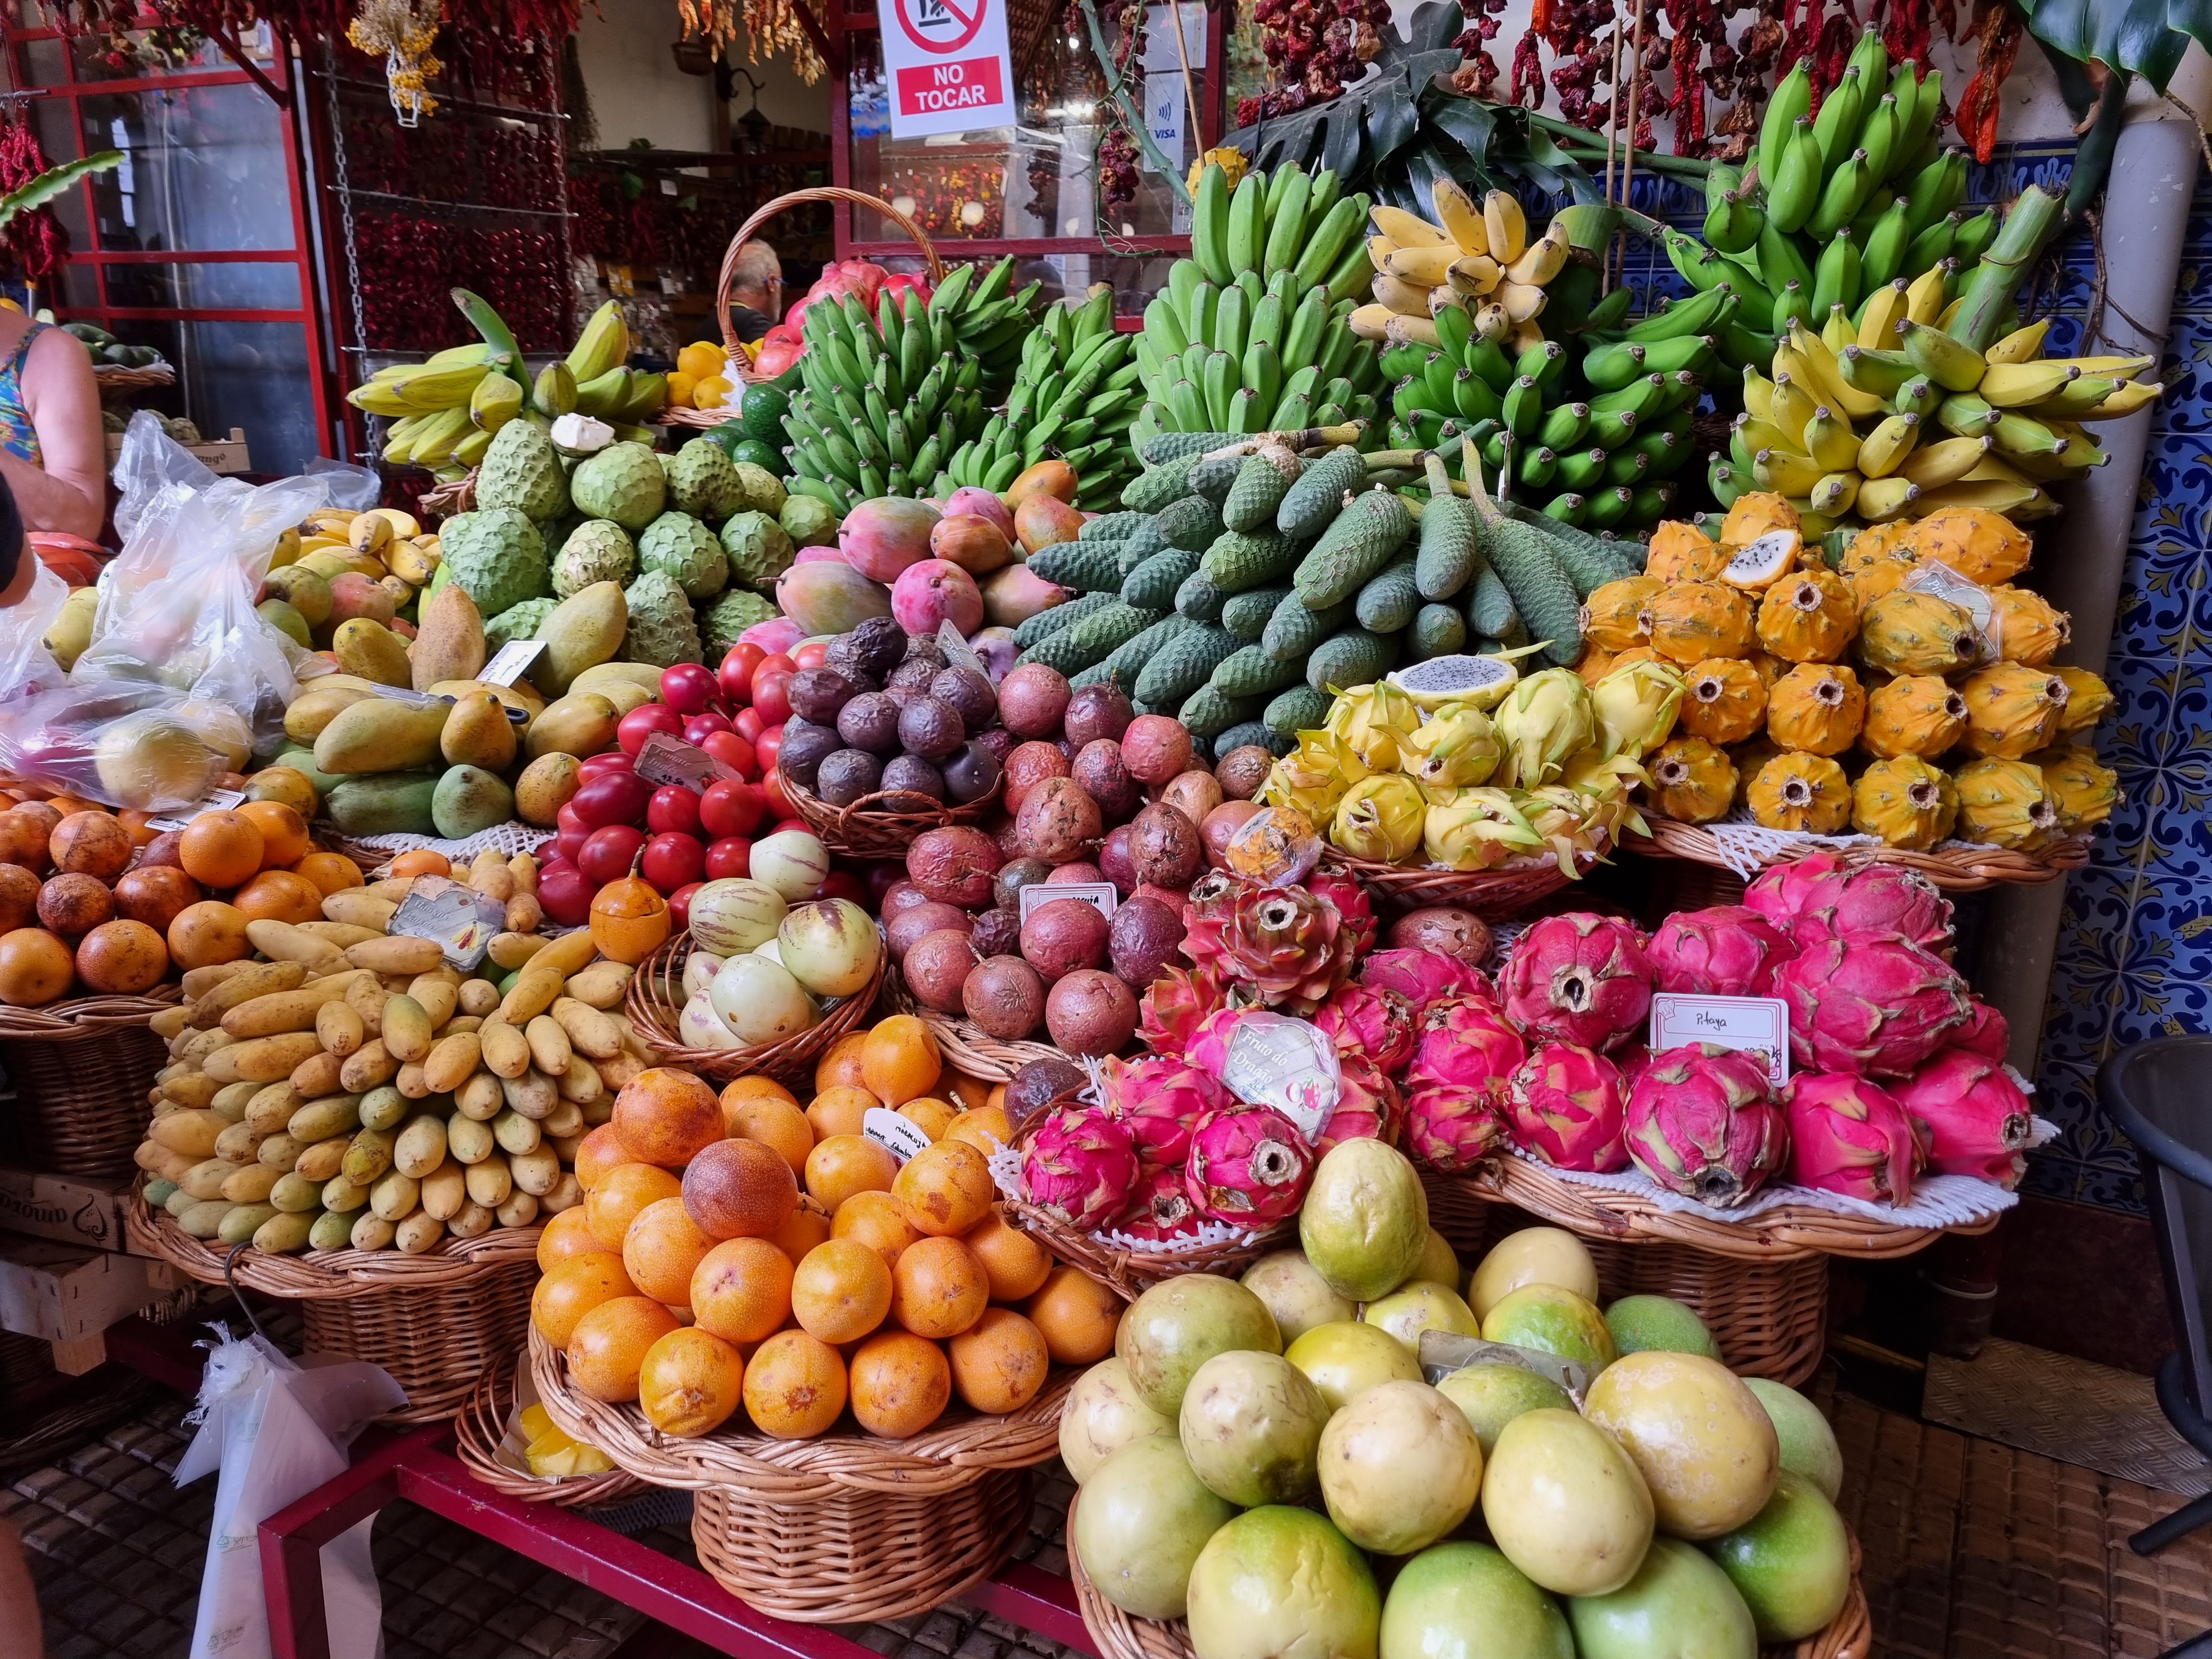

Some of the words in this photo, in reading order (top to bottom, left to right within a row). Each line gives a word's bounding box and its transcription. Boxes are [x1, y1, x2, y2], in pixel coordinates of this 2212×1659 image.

[933, 64, 964, 86] NO
[915, 84, 986, 110] TOCAR
[1154, 129, 1176, 139] VISA
[198, 453, 226, 466] ango
[1927, 579, 1950, 602] Pita
[652, 747, 692, 767] Tomate
[1696, 1011, 1727, 1031] Pitaya
[1242, 1030, 1273, 1056] Fruto
[1271, 1051, 1288, 1066] do
[1232, 1051, 1273, 1084] Dragão
